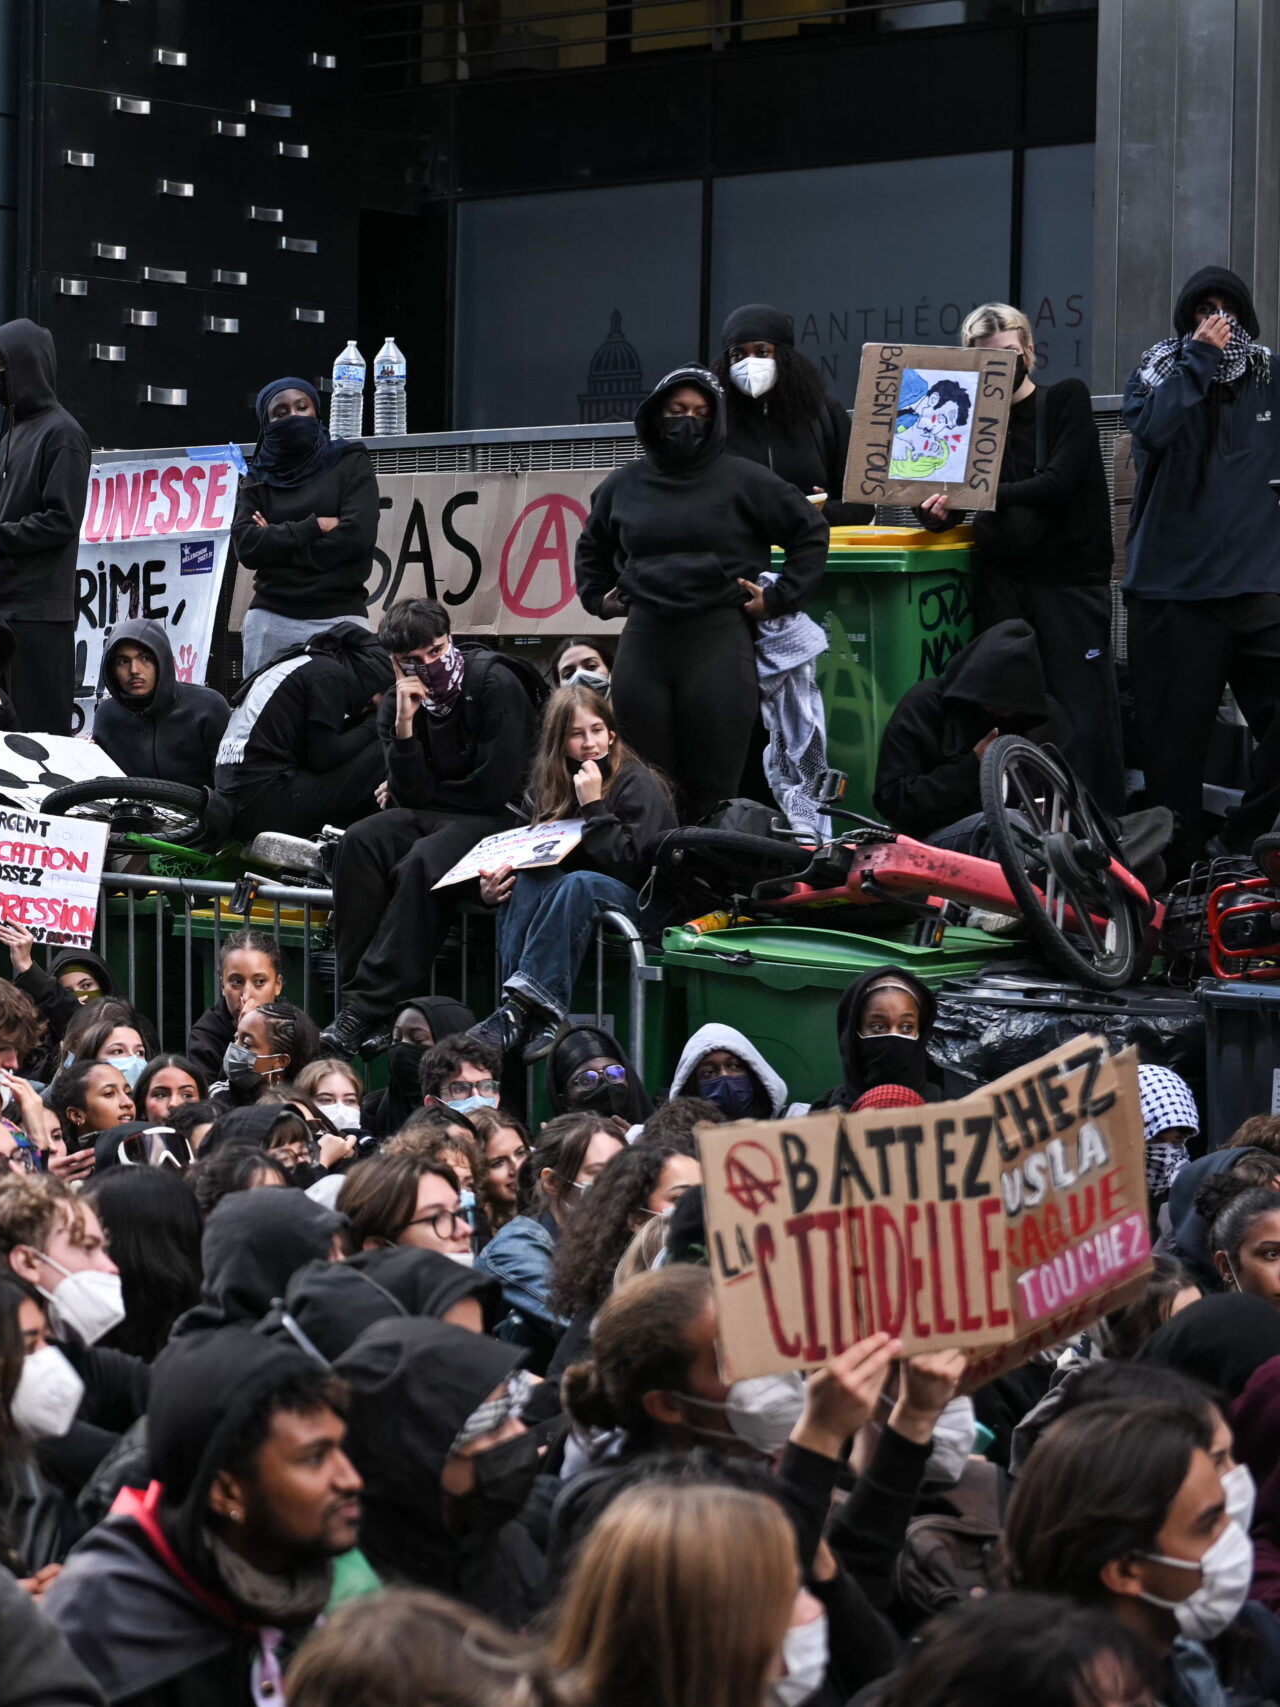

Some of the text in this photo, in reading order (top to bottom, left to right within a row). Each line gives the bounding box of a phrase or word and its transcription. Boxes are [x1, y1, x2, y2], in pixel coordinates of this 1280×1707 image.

[860, 345, 903, 496] BAISENT TOUS
[969, 361, 1008, 492] ILS NOUS
[714, 1225, 753, 1279] LA
[1017, 1215, 1147, 1320] TOUCHEZ
